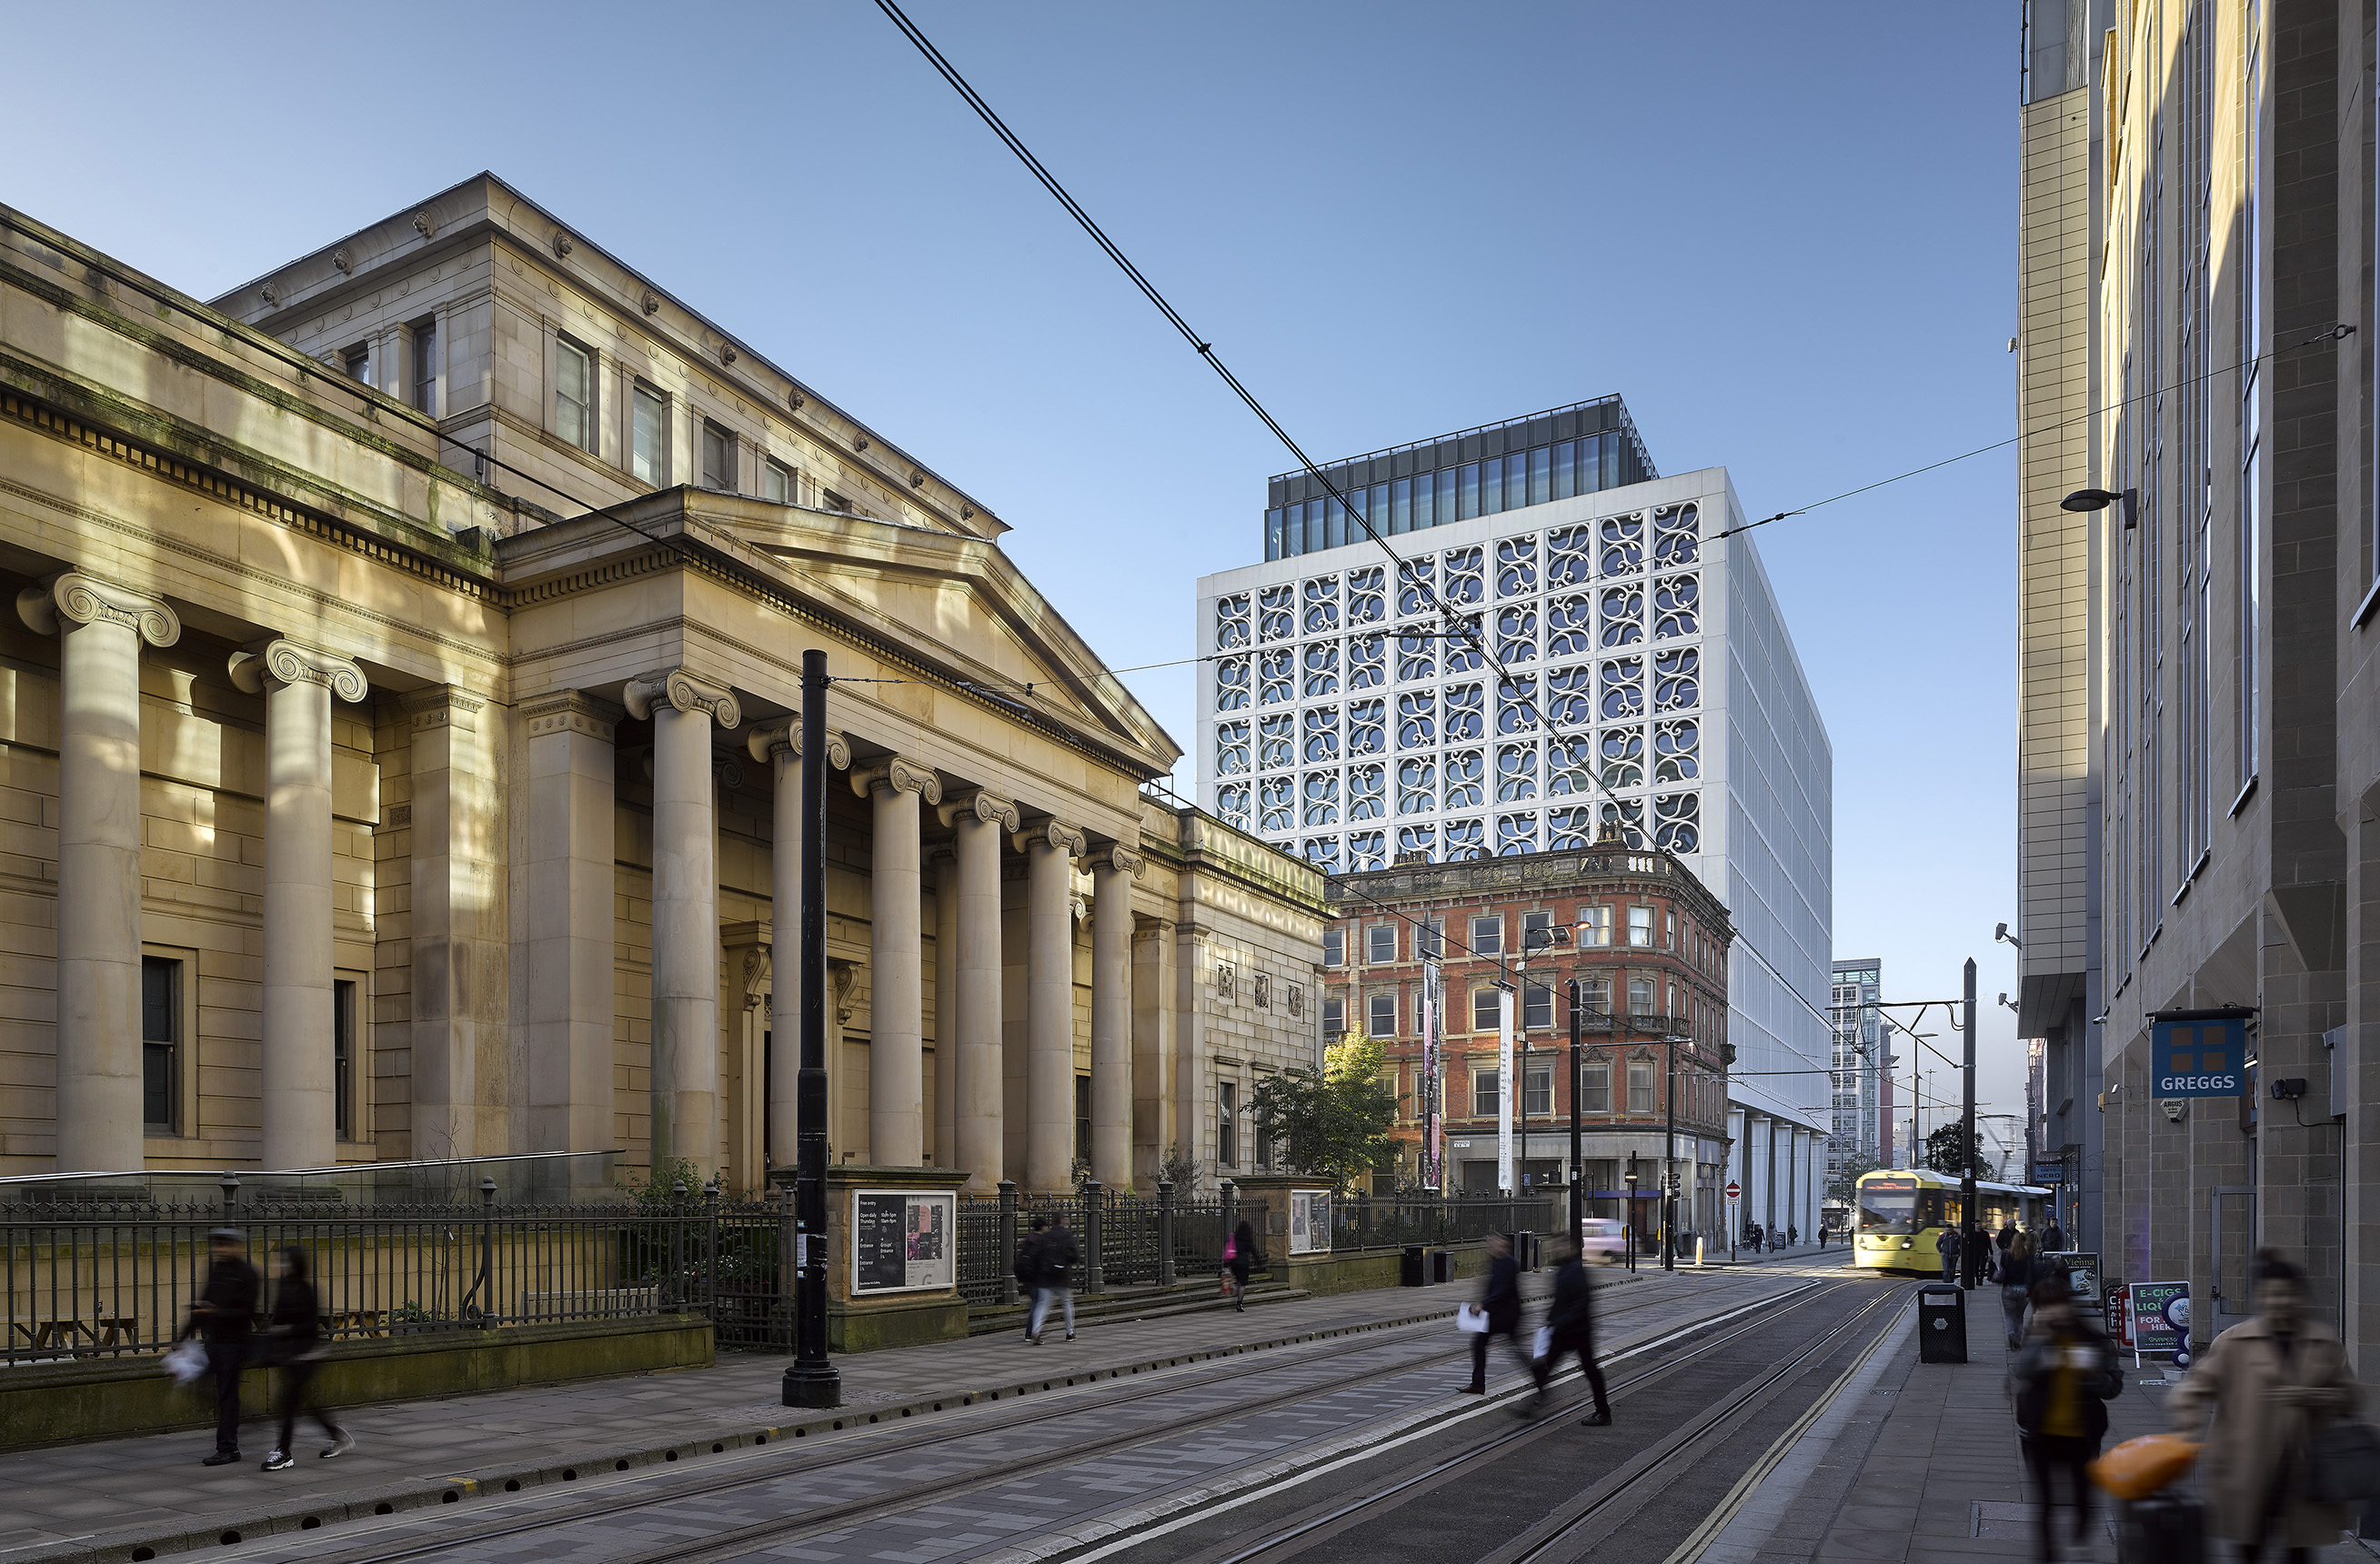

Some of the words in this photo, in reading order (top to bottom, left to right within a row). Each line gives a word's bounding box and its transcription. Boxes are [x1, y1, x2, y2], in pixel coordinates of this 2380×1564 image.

[2161, 1075, 2235, 1090] GREGGS
[2064, 1258, 2095, 1266] Vienna
[2140, 1288, 2181, 1298] E-CIGS
